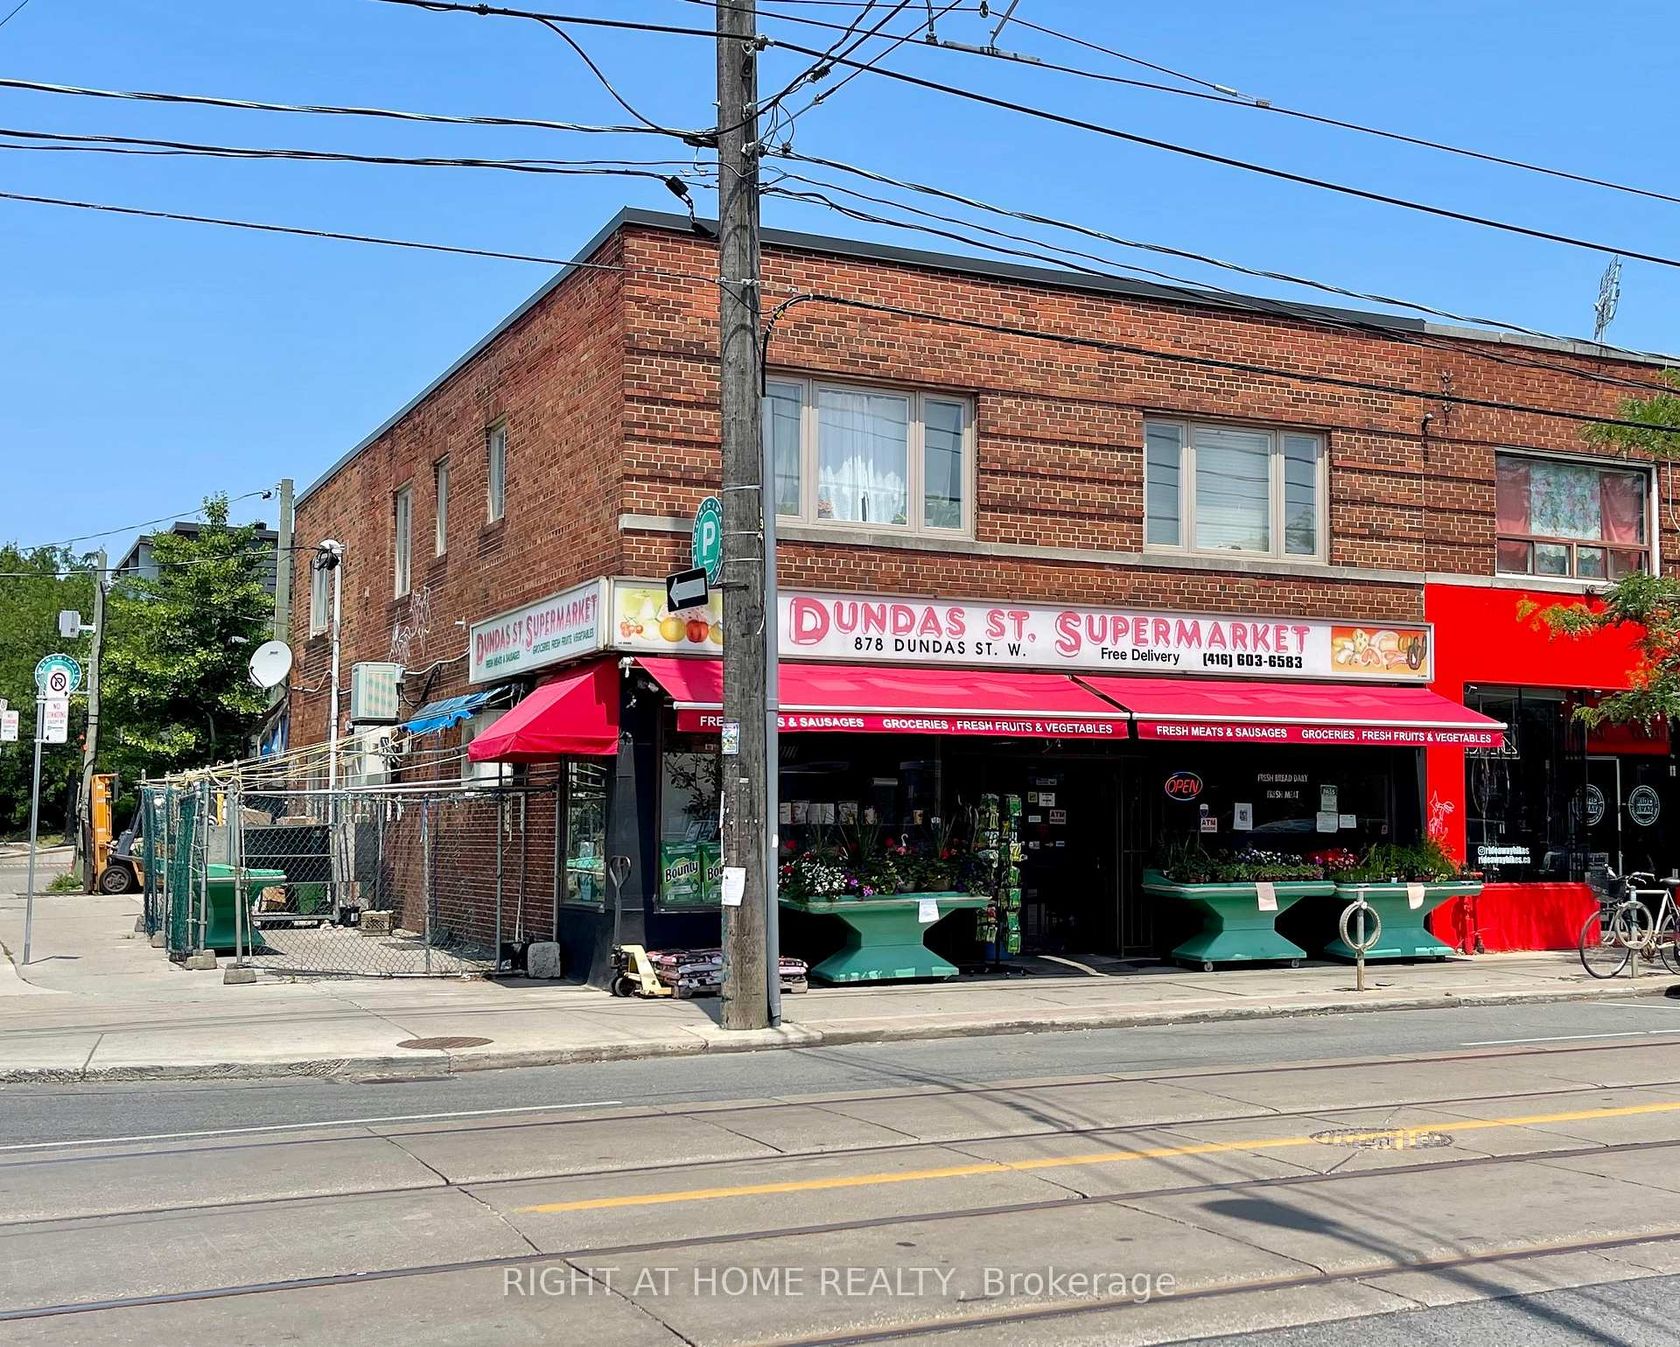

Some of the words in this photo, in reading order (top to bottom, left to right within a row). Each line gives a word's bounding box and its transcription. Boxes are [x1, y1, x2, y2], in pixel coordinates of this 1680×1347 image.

[476, 624, 511, 665] DUNDAS
[512, 620, 524, 645] ST.
[526, 593, 598, 651] SUPERMARKET
[788, 596, 967, 646] DUNDAS
[985, 608, 1037, 643] ST.
[1054, 610, 1311, 658] SUPERMARKET
[853, 637, 885, 652] 878
[894, 638, 966, 655] DUNDAS
[975, 642, 999, 657] ST.
[1007, 643, 1027, 657] W.
[1100, 647, 1128, 661] Free
[1131, 648, 1180, 666] Delivery
[1202, 652, 1233, 668] (416)
[1236, 654, 1303, 669] 603-6583
[700, 715, 724, 727] FRE
[788, 716, 798, 727] &
[799, 717, 865, 728] SAUSAGES
[957, 720, 993, 731] FRESH
[995, 721, 1033, 732] FRUITS
[1035, 722, 1044, 732] &
[1044, 723, 1113, 734] VEGETABLES
[1156, 725, 1189, 736] FRESH
[1191, 726, 1224, 737] MEATS
[1225, 727, 1233, 737] &
[1235, 727, 1288, 738] SAUSAGES
[1361, 730, 1392, 741] FRESH
[1393, 731, 1425, 742] FRUITS
[1426, 732, 1434, 742] &
[1435, 732, 1492, 743] VEGETABLES
[1257, 773, 1274, 783] FRESH
[1167, 778, 1200, 794] OPEN
[665, 860, 699, 883] Bounty
